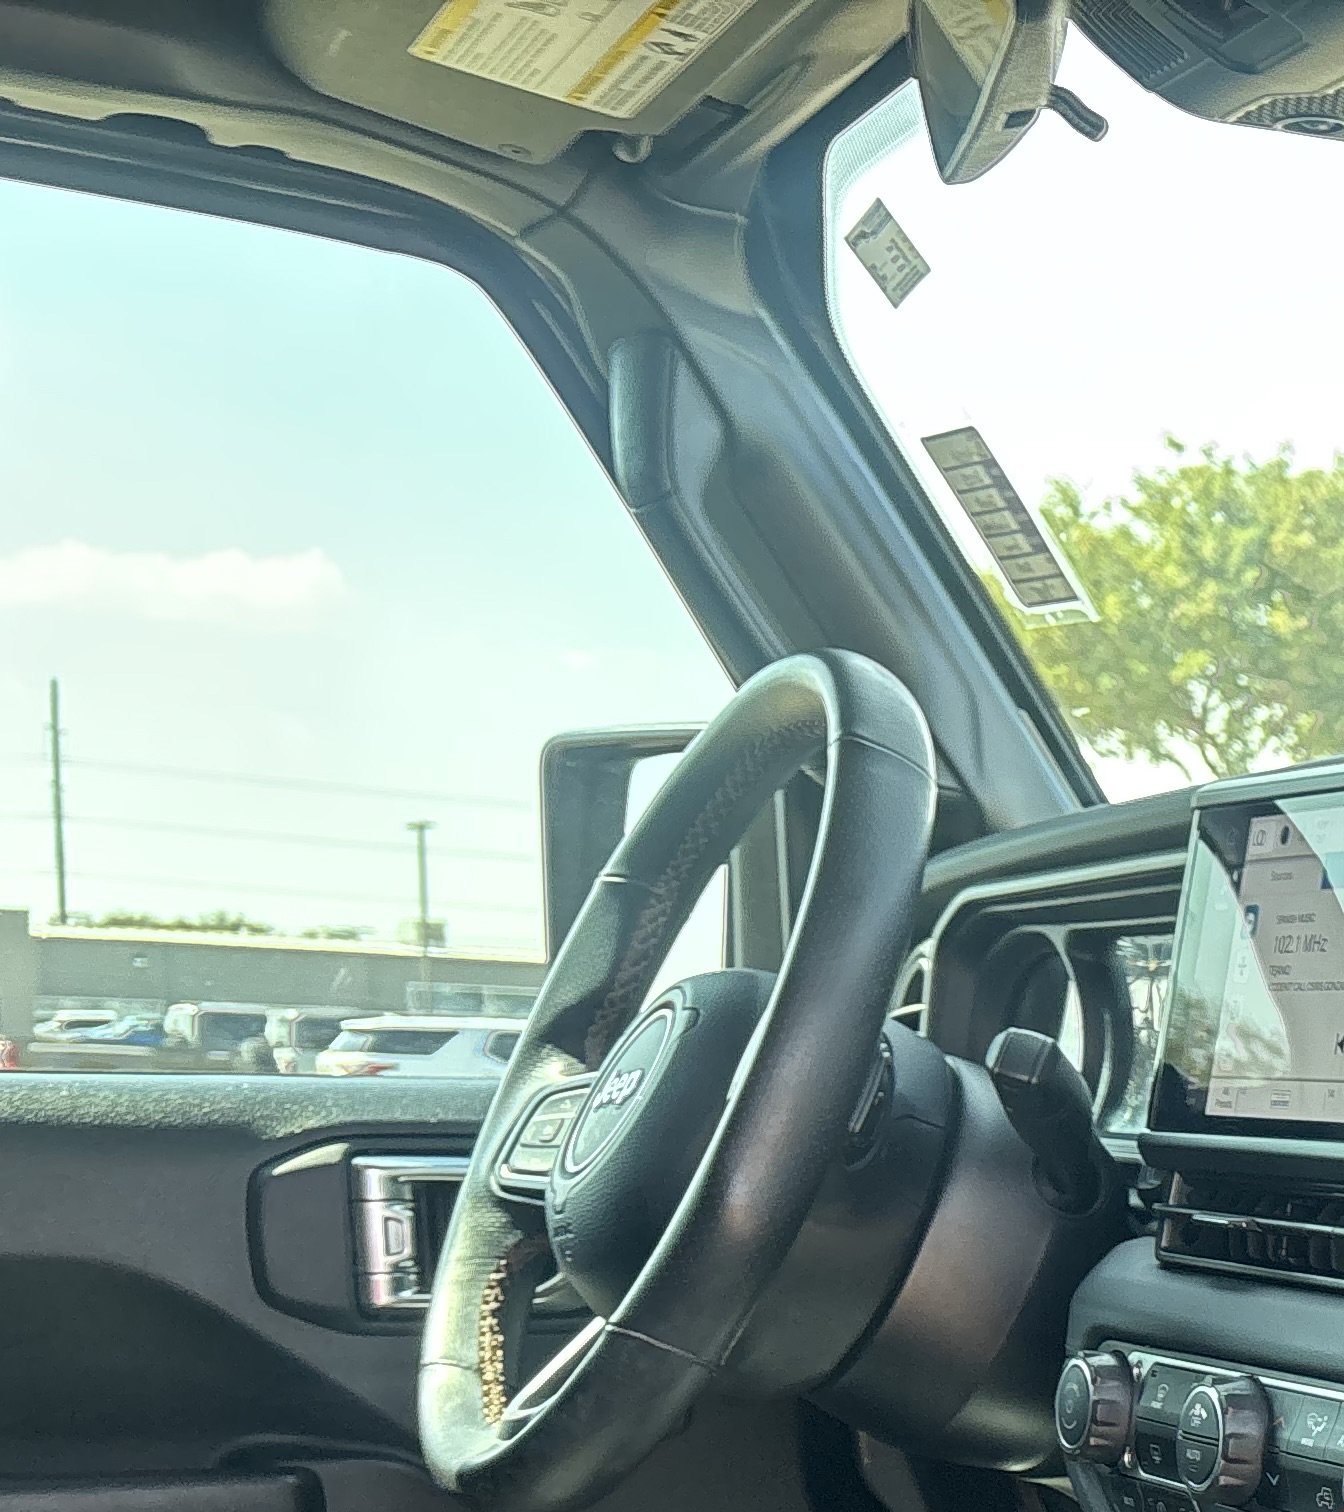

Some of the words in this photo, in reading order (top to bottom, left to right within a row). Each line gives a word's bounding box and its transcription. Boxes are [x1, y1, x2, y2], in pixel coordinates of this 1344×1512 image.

[1273, 934, 1301, 955] 102.1
[1302, 933, 1329, 953] MHz
[592, 1068, 643, 1109] Jeep
